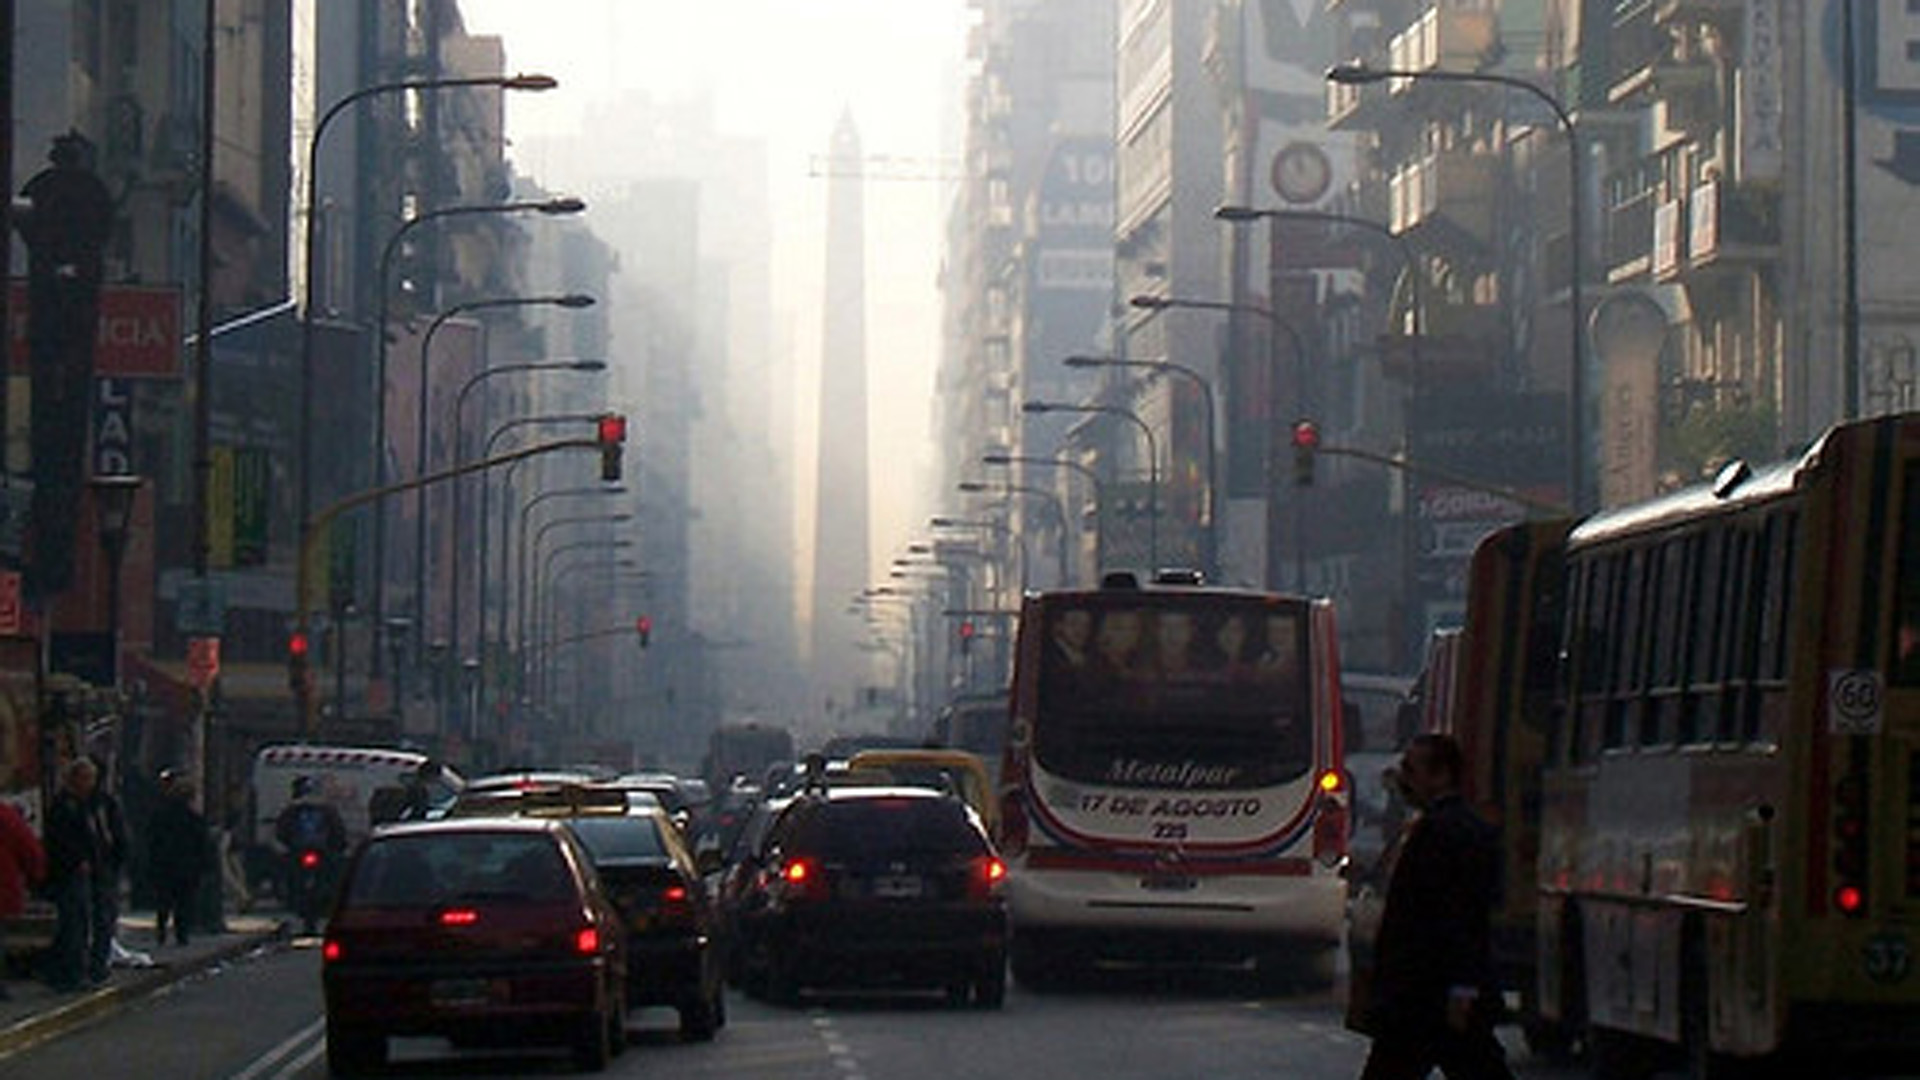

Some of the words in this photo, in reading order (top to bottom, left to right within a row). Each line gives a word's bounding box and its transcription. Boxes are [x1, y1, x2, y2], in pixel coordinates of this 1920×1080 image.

[1105, 759, 1238, 787] Metalpar
[1080, 795, 1107, 812] 17
[1110, 797, 1149, 815] DE
[1152, 798, 1262, 817] AGOSTO
